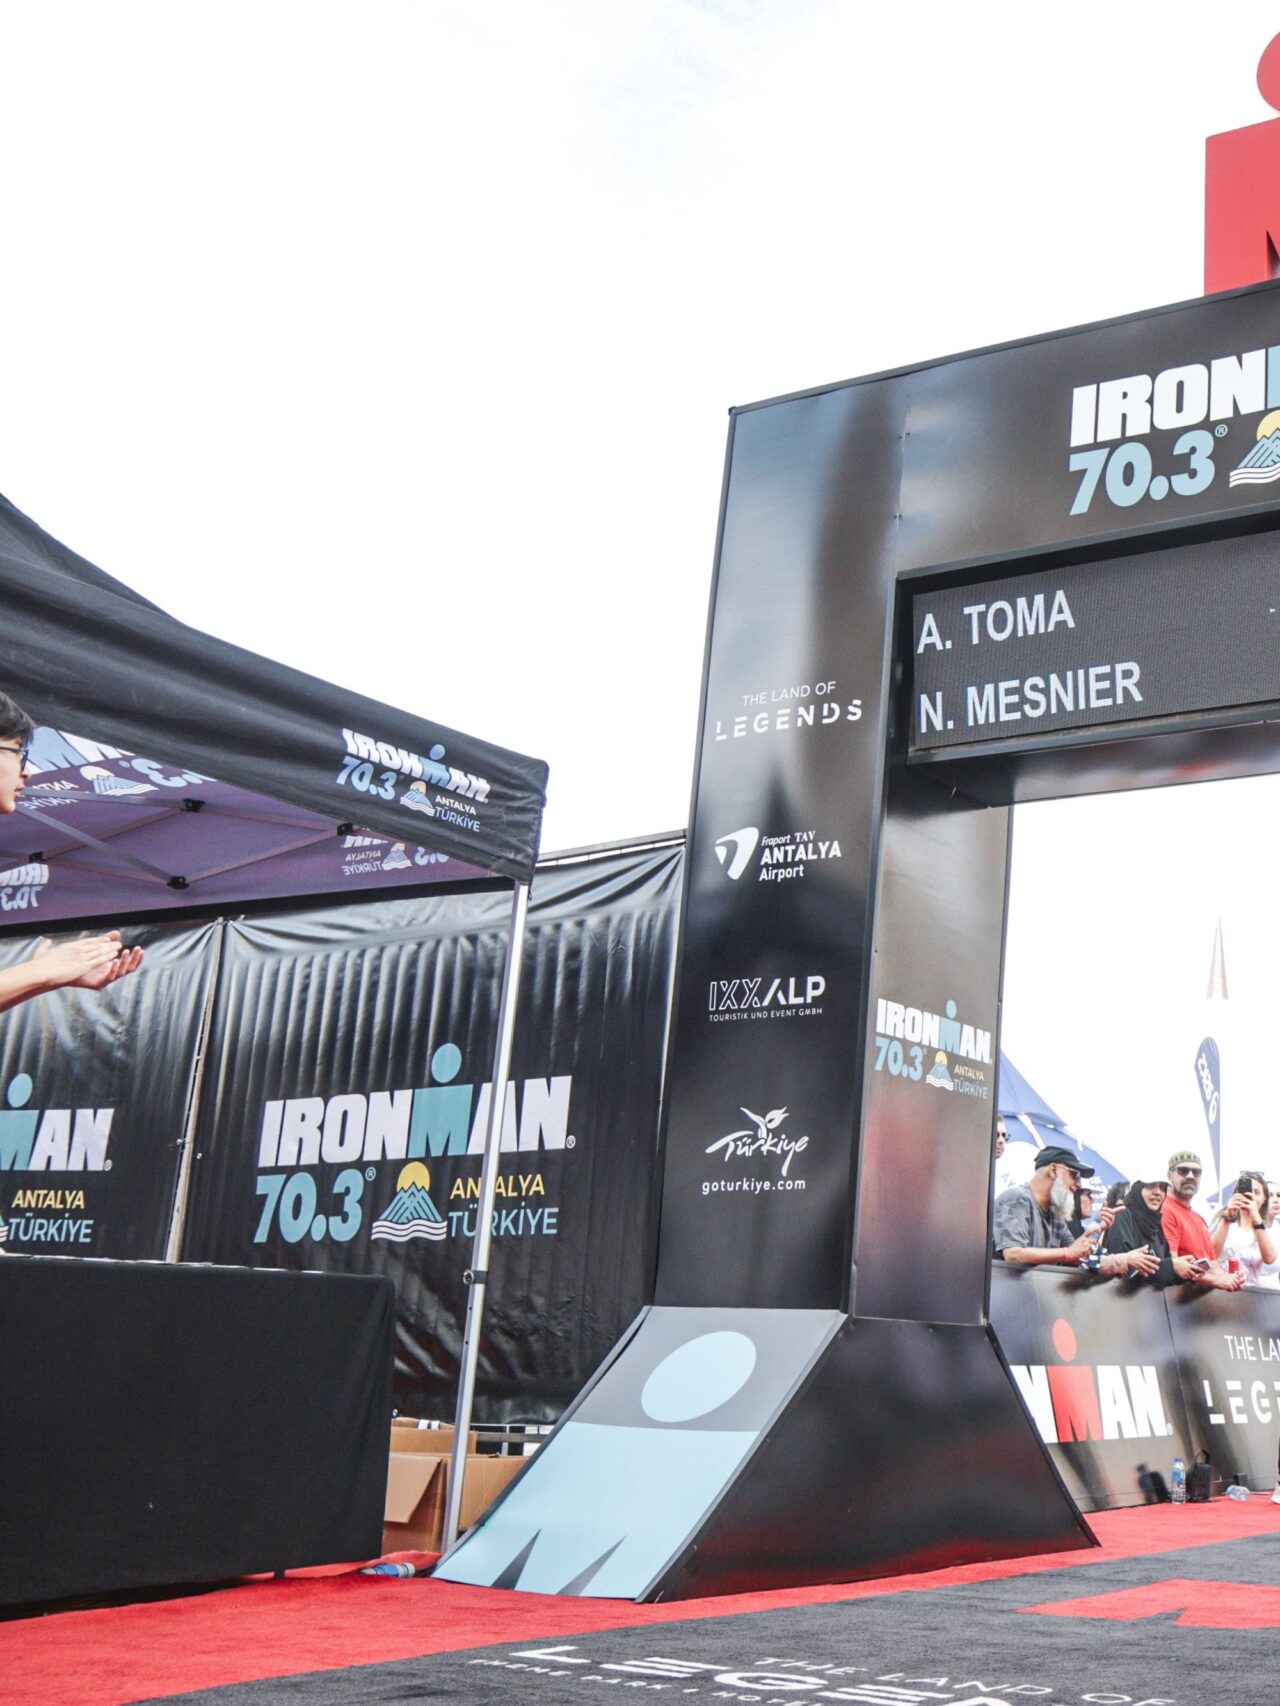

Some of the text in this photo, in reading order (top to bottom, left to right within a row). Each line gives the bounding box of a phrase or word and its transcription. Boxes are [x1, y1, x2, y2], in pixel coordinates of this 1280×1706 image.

[1068, 429, 1216, 516] 70.3
[916, 589, 1076, 655] A. TOMA
[742, 681, 836, 707] THE LAND OF
[919, 661, 1144, 733] N. MESNIER
[715, 699, 863, 741] LEGENDS
[336, 755, 398, 800] 70.3
[342, 728, 491, 802] IRONMAN
[434, 806, 481, 832] TÜRKİYE
[435, 795, 477, 815] ANTALYA
[760, 840, 842, 866] ANTALYA
[761, 830, 816, 848] Fraport TAV
[759, 864, 805, 882] Airport
[709, 975, 826, 1011] IXXALP
[709, 1007, 823, 1022] TOURISTIK UND EVENT GMBH
[876, 998, 992, 1065] IRONMAN
[875, 1036, 924, 1081] 70.3
[954, 1064, 984, 1081] ANTALYA
[953, 1078, 989, 1099] TÜRKİYE
[258, 1075, 573, 1168] IRONMAN
[705, 1130, 810, 1177] Türkiye
[11, 1190, 86, 1209] ANTALYA
[450, 1174, 545, 1200] ANALYA
[702, 1178, 807, 1195] goturkiye.com
[253, 1168, 364, 1244] 70.3
[8, 1212, 94, 1243] TÜRKİYE
[1223, 1335, 1255, 1360] THE
[754, 1656, 867, 1676] THE
[876, 1672, 1053, 1695] LAND
